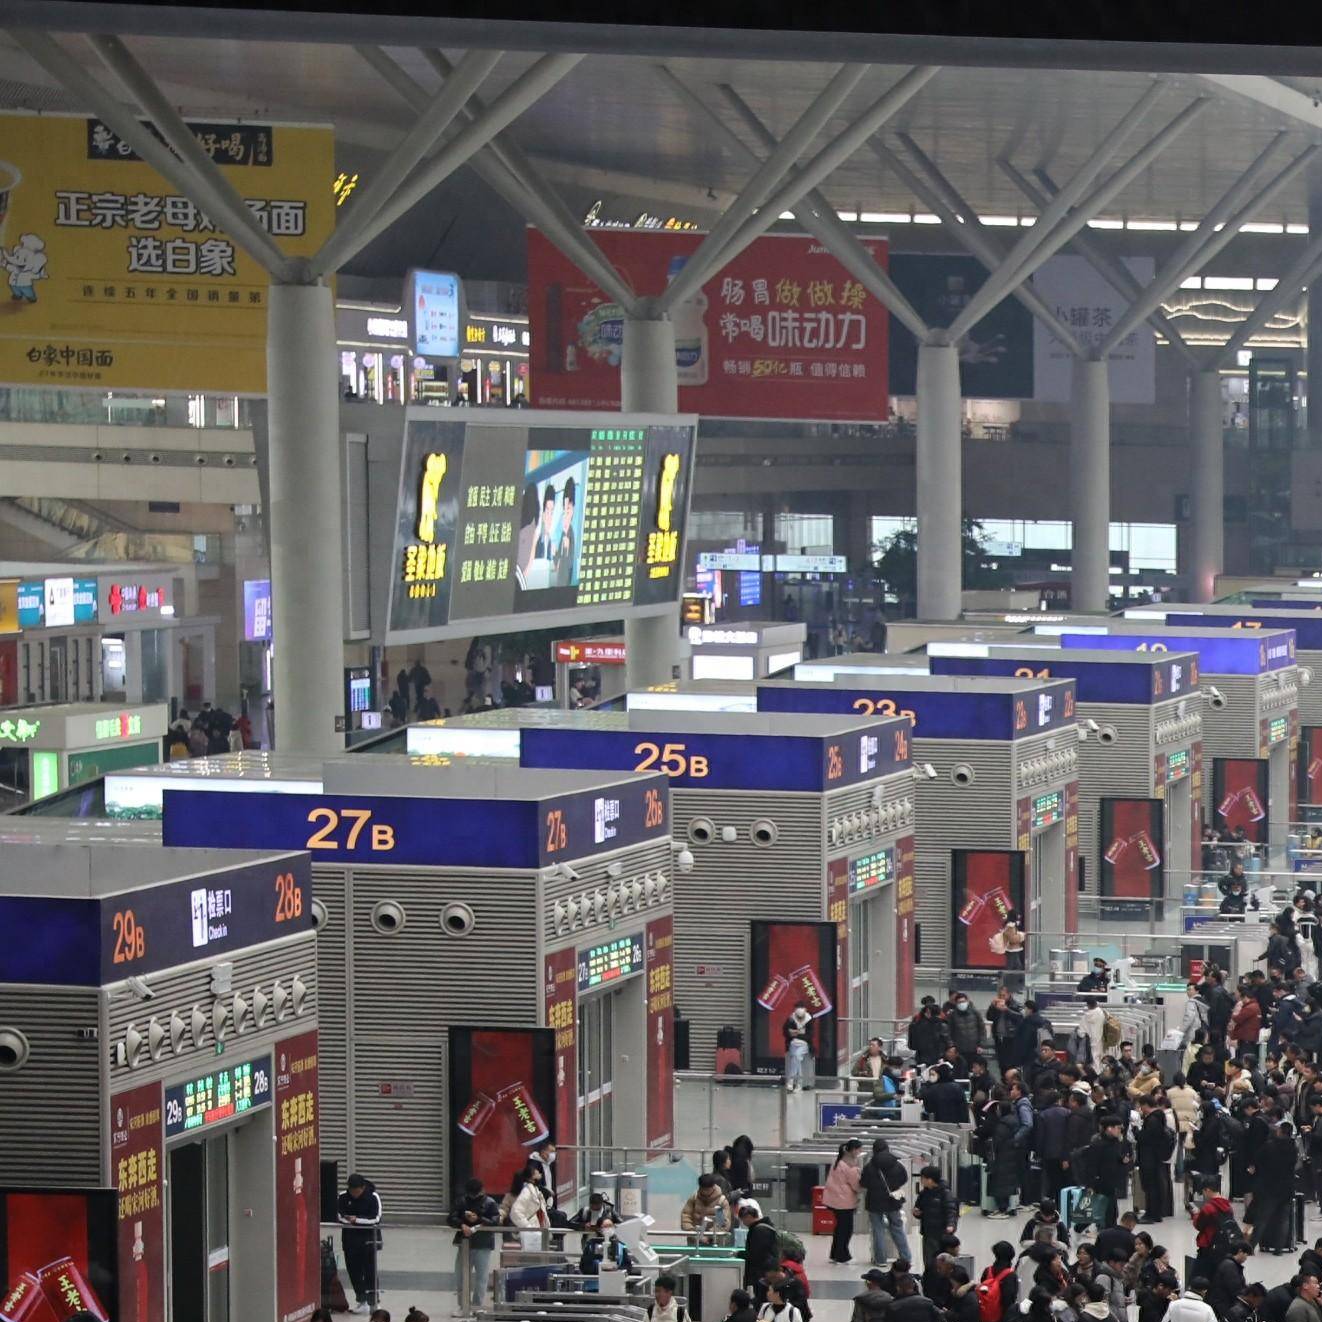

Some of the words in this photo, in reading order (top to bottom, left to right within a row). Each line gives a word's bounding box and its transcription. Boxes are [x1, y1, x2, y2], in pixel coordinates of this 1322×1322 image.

[55, 191, 306, 236] 正宗老母面
[127, 237, 234, 277] 选白象
[720, 277, 867, 309] 肠胃做做操
[719, 311, 867, 350] 常喝味动力
[634, 742, 709, 778] 25B
[644, 788, 663, 828] 26B
[306, 807, 395, 851] 27B
[546, 809, 567, 853] 27B
[208, 888, 232, 921] 检票口
[274, 872, 303, 924] 28B
[112, 908, 146, 965] 29B
[253, 1069, 269, 1096] 28B
[166, 1099, 183, 1126] 29B
[280, 1091, 314, 1132] 东奔西走
[513, 1094, 537, 1134] 王老吉
[118, 1147, 158, 1192] 东奔西走
